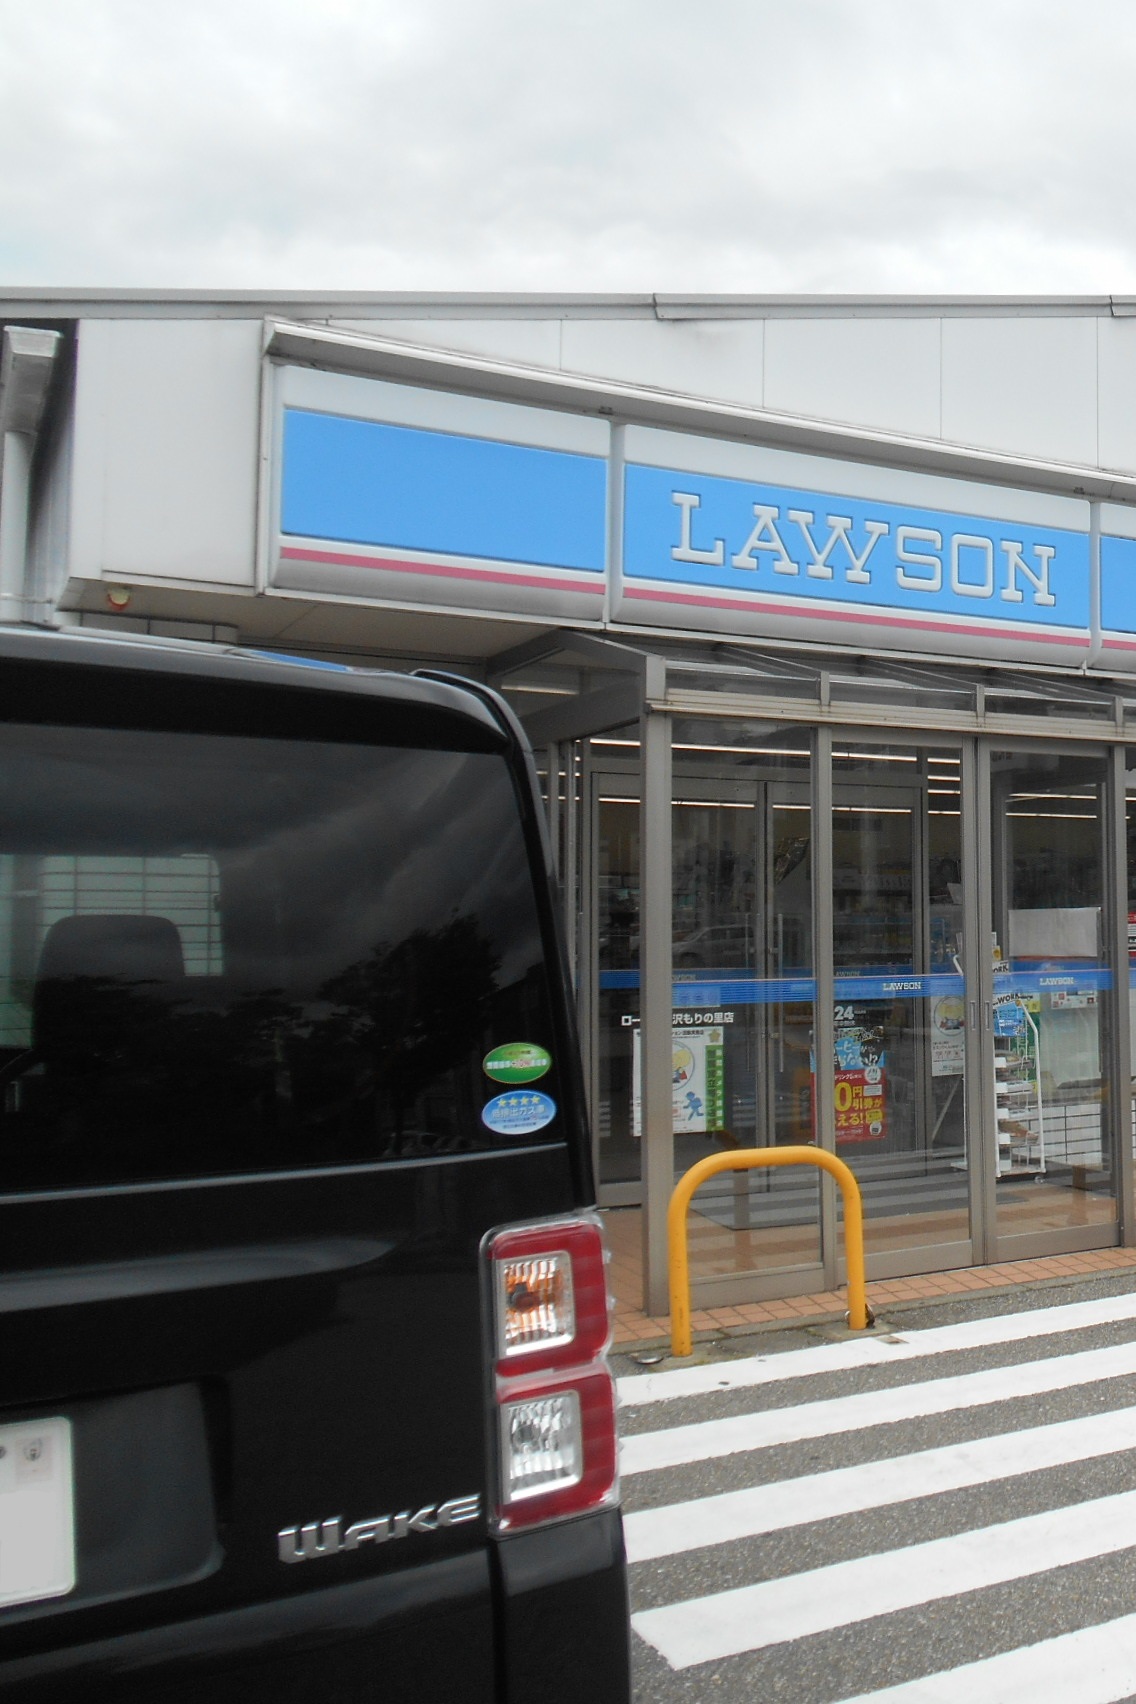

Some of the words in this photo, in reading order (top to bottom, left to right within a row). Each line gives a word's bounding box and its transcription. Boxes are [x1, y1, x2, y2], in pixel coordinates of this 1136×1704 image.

[670, 490, 1057, 607] LAWSON
[882, 981, 922, 991] LAWSON
[1040, 977, 1075, 986] LAWSON
[621, 1012, 735, 1027] ロー沢もりの里店
[834, 1005, 855, 1021] 24
